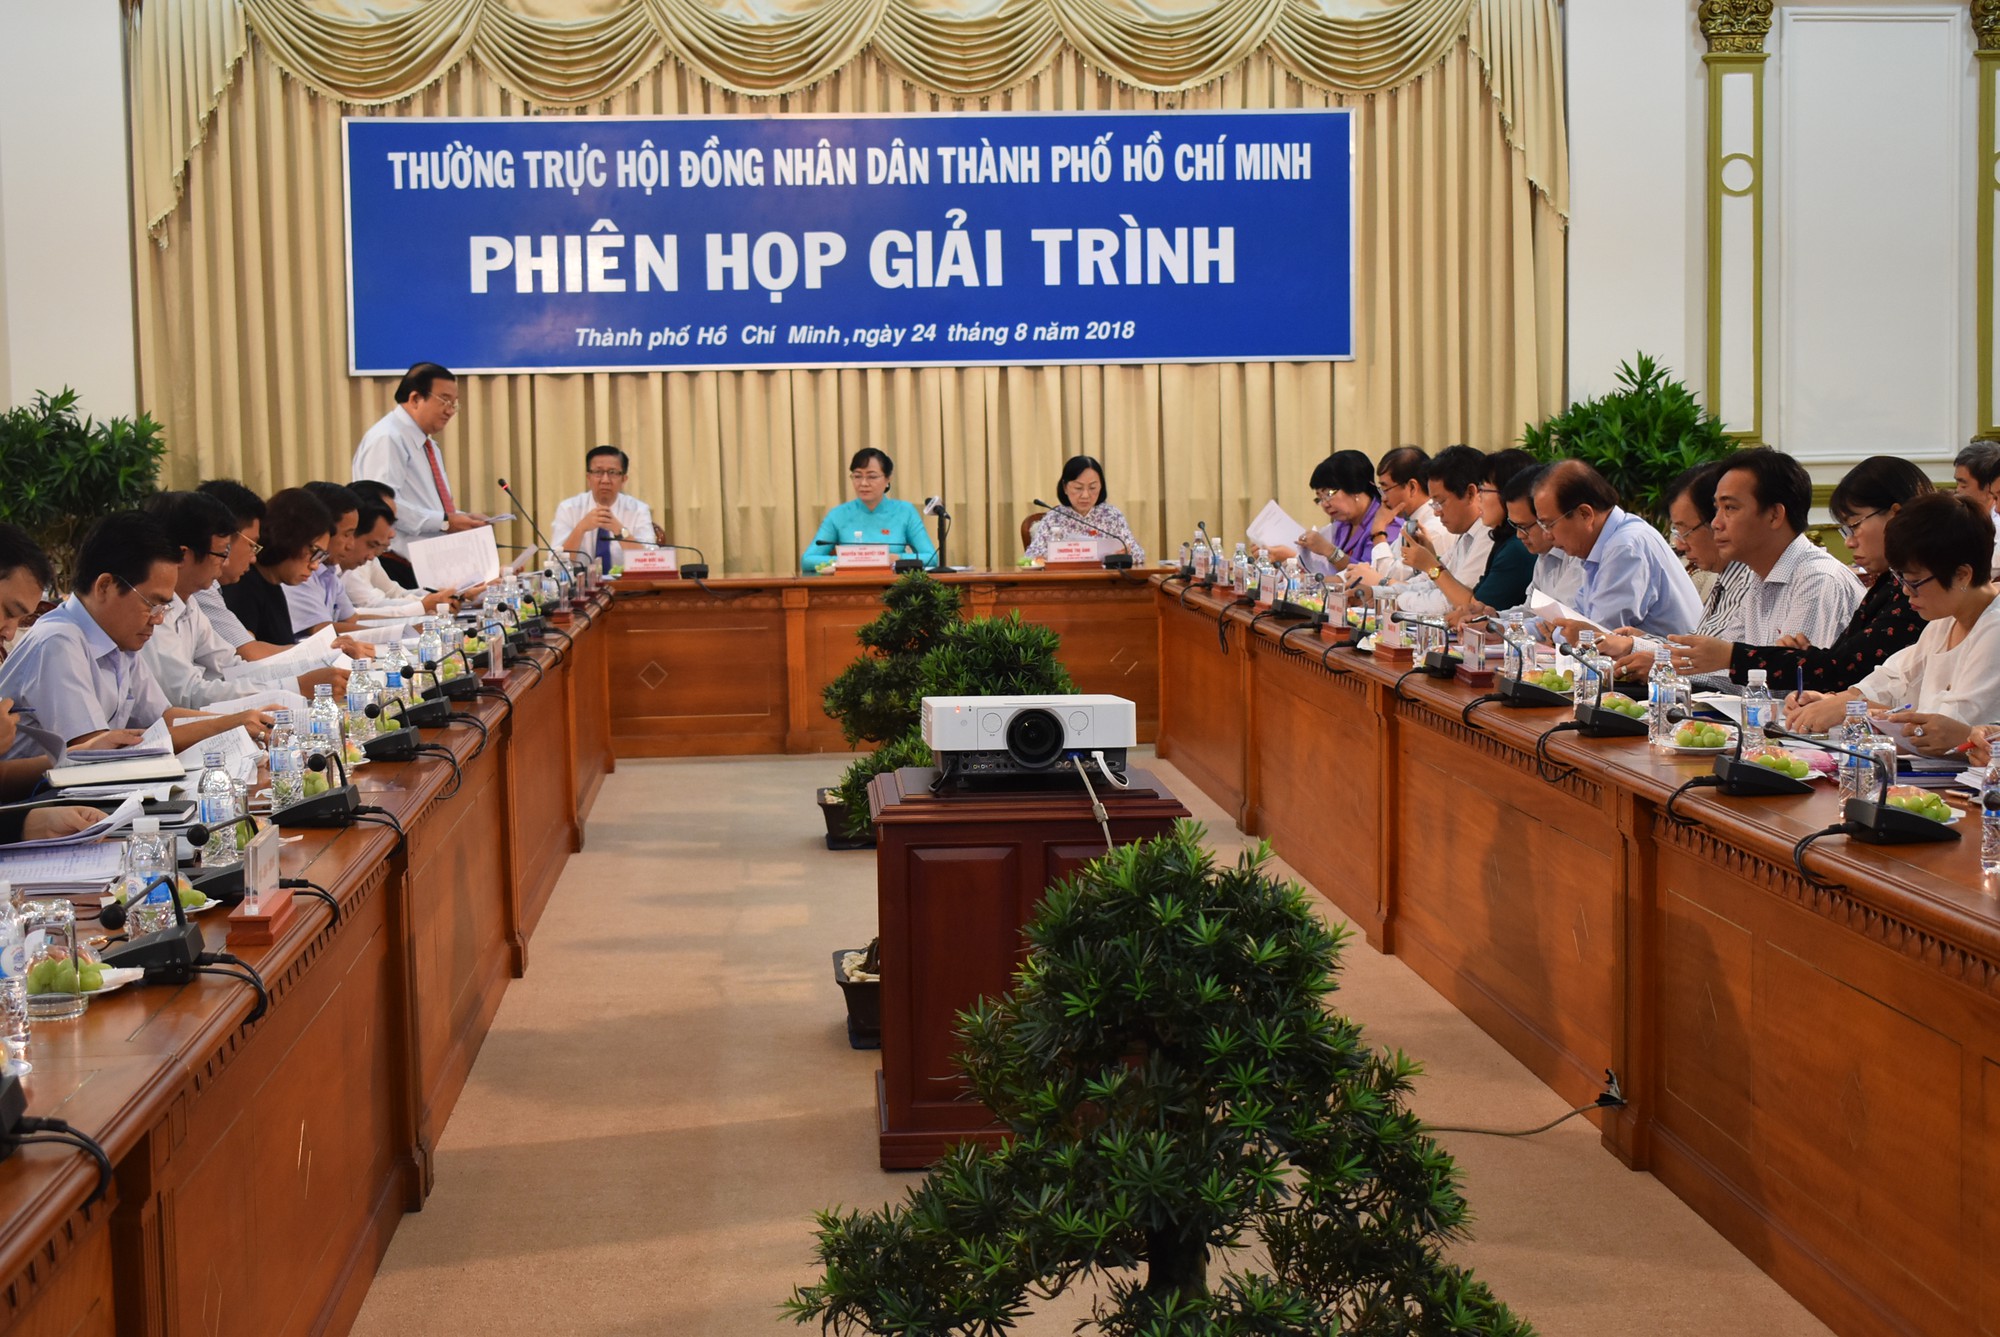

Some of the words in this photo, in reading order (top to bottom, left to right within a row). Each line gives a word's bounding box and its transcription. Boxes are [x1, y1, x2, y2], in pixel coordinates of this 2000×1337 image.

[387, 140, 515, 190] THƯỜNG
[523, 142, 607, 196] TRỰC
[616, 139, 669, 196] HỘI
[678, 135, 765, 188] ĐỒNG
[773, 137, 857, 186] NHÂN
[866, 137, 930, 185] DÂN
[936, 137, 1040, 184] THÀNH
[1051, 131, 1114, 183] PHỐ
[1123, 130, 1164, 182] HỒ
[1174, 134, 1227, 182] CHÍ
[1235, 142, 1311, 181] MINH
[469, 218, 679, 294] PHIÊN
[705, 231, 847, 304] HỌP
[869, 208, 1003, 289] GIẢI
[1031, 213, 1235, 286] TRÌNH
[574, 327, 643, 347] Thành
[646, 324, 691, 351] phố
[741, 324, 777, 345] Chí
[911, 323, 937, 342] 24
[947, 321, 1009, 346] tháng
[1014, 322, 1028, 342] 8
[1032, 321, 1080, 341] năm
[1085, 320, 1136, 340] 2018
